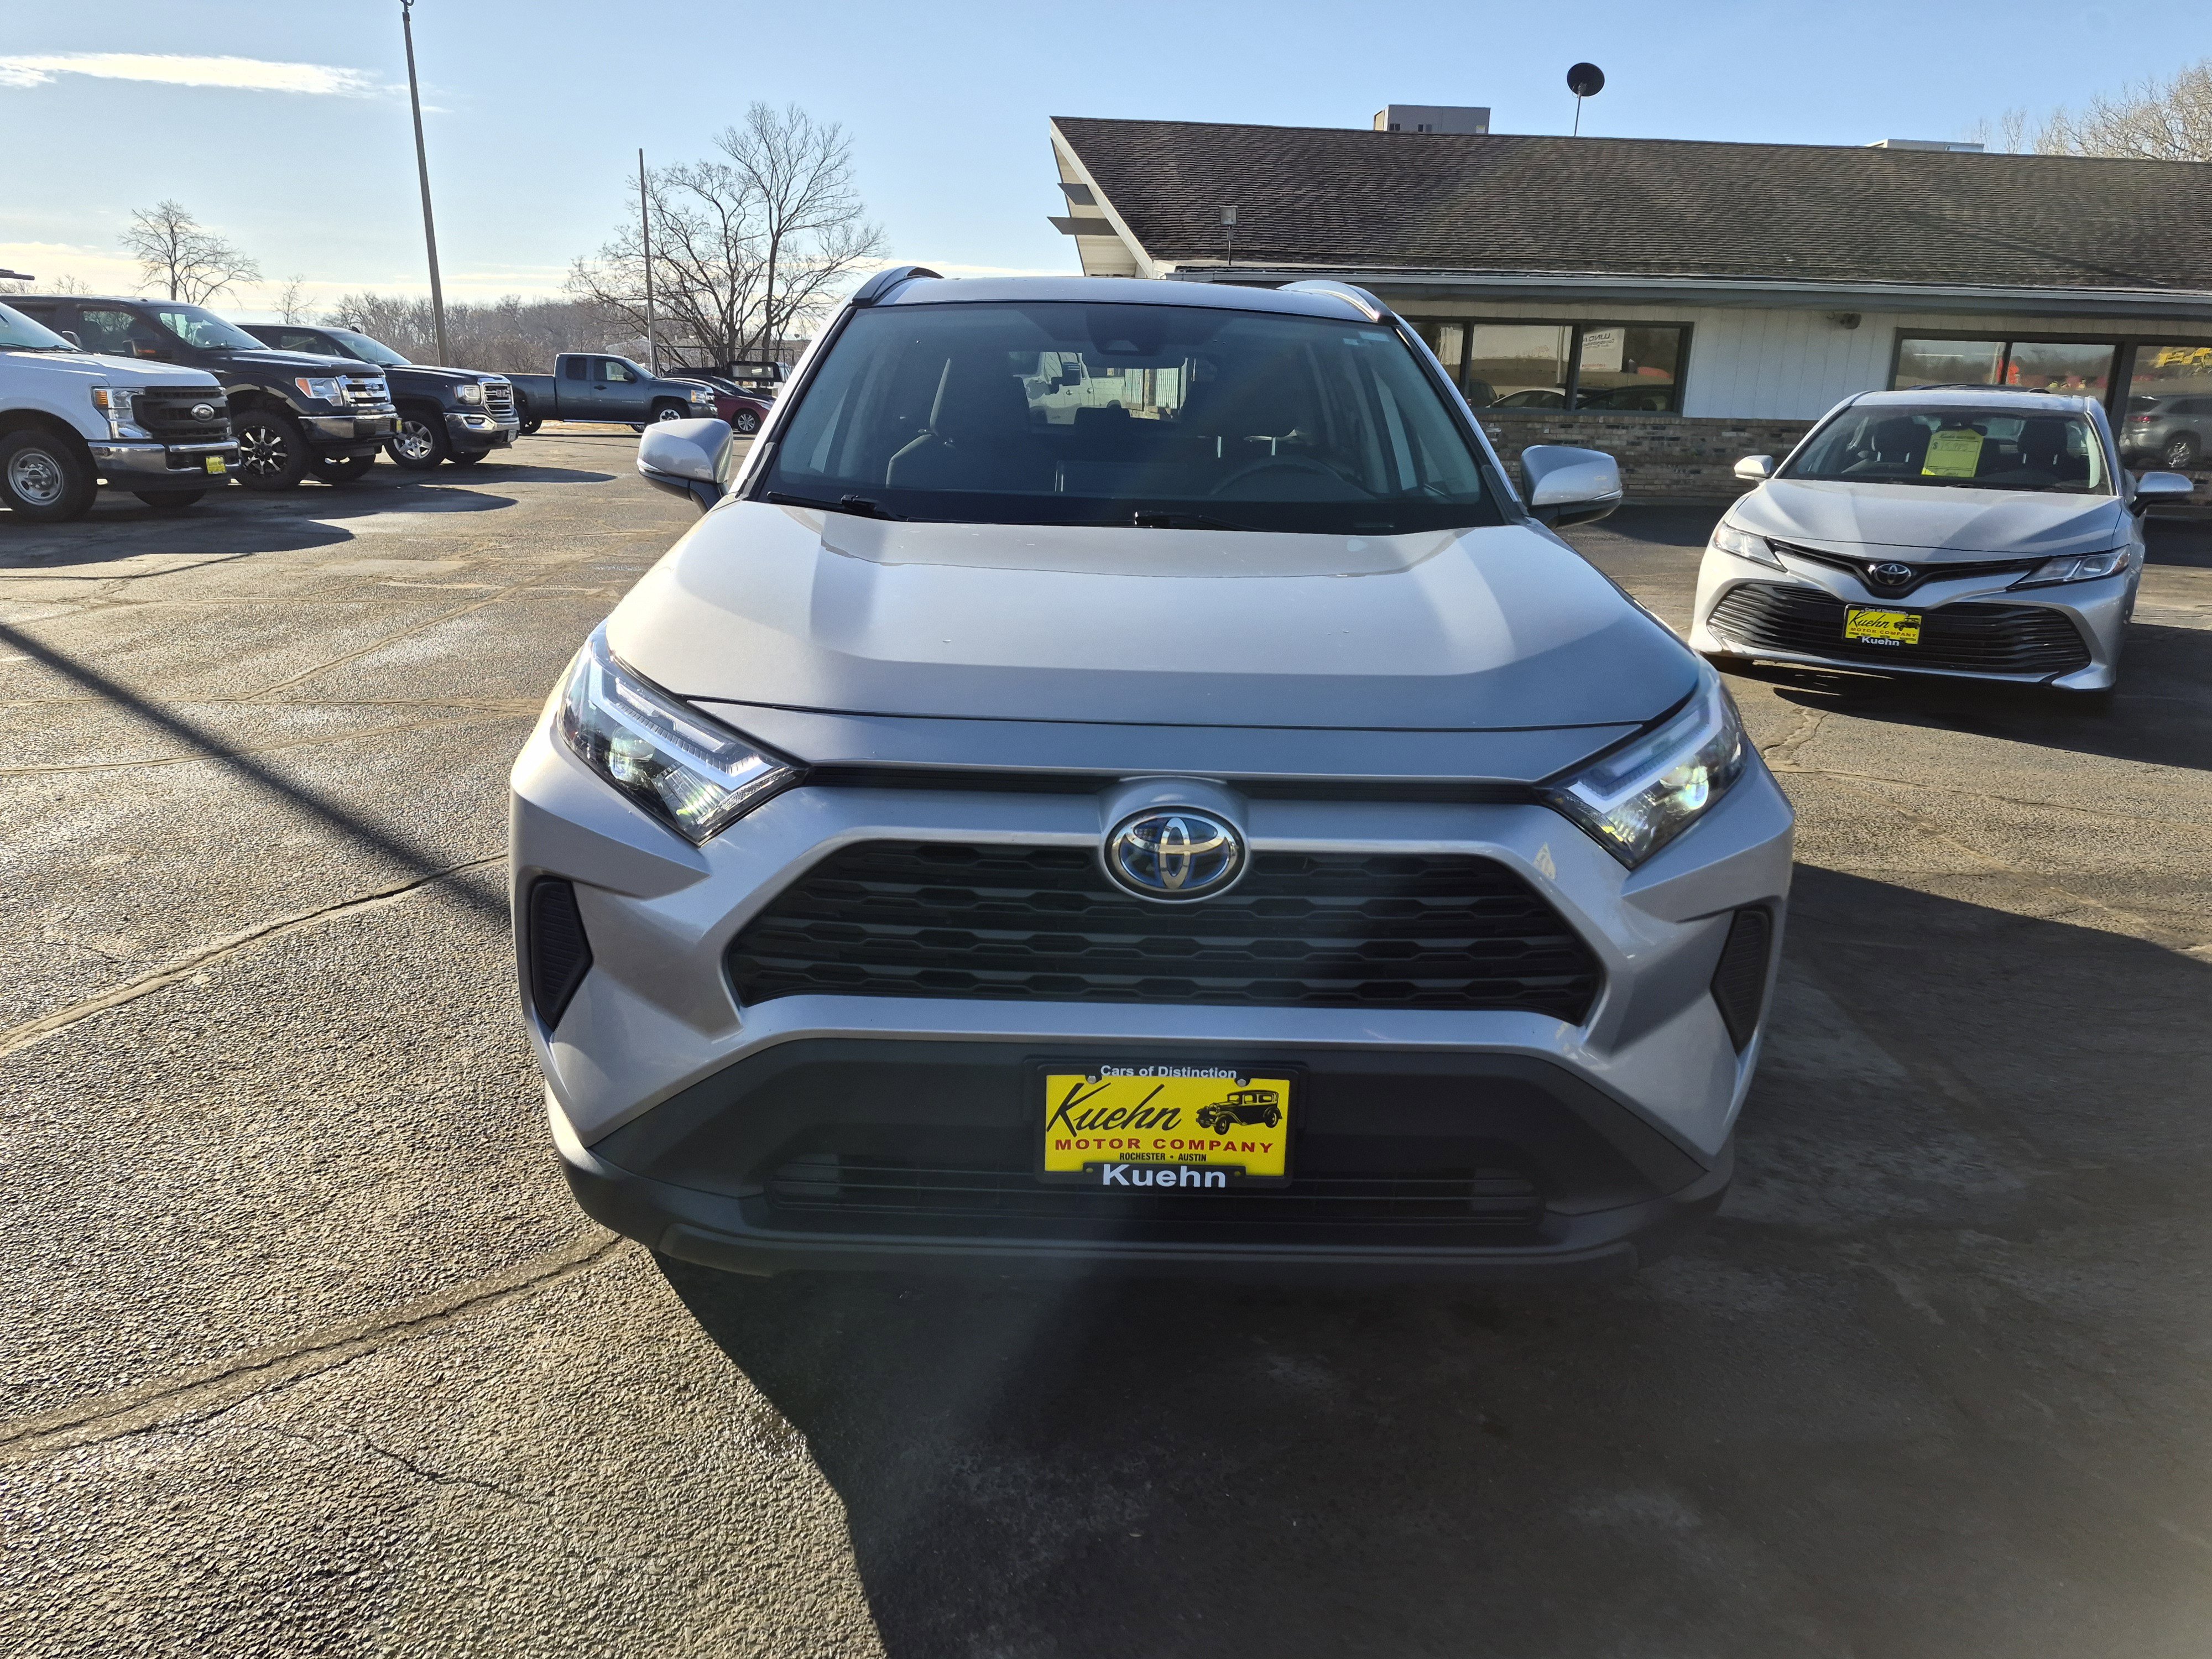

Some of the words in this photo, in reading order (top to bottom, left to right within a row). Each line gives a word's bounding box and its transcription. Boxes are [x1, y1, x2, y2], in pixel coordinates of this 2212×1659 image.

[1849, 612, 1890, 629] Kuehn
[1861, 636, 1900, 646] Kuehn
[1100, 1065, 1134, 1076] Cars
[1139, 1066, 1155, 1077] of
[1158, 1066, 1237, 1078] Distinction
[1046, 1082, 1182, 1138] Kuehn
[1055, 1138, 1140, 1150] MOTOR
[1152, 1138, 1274, 1153] COMPANY
[1119, 1152, 1165, 1161] ROCHESTER
[1178, 1153, 1207, 1162] AUSTIN
[1103, 1164, 1226, 1188] Kuehn
